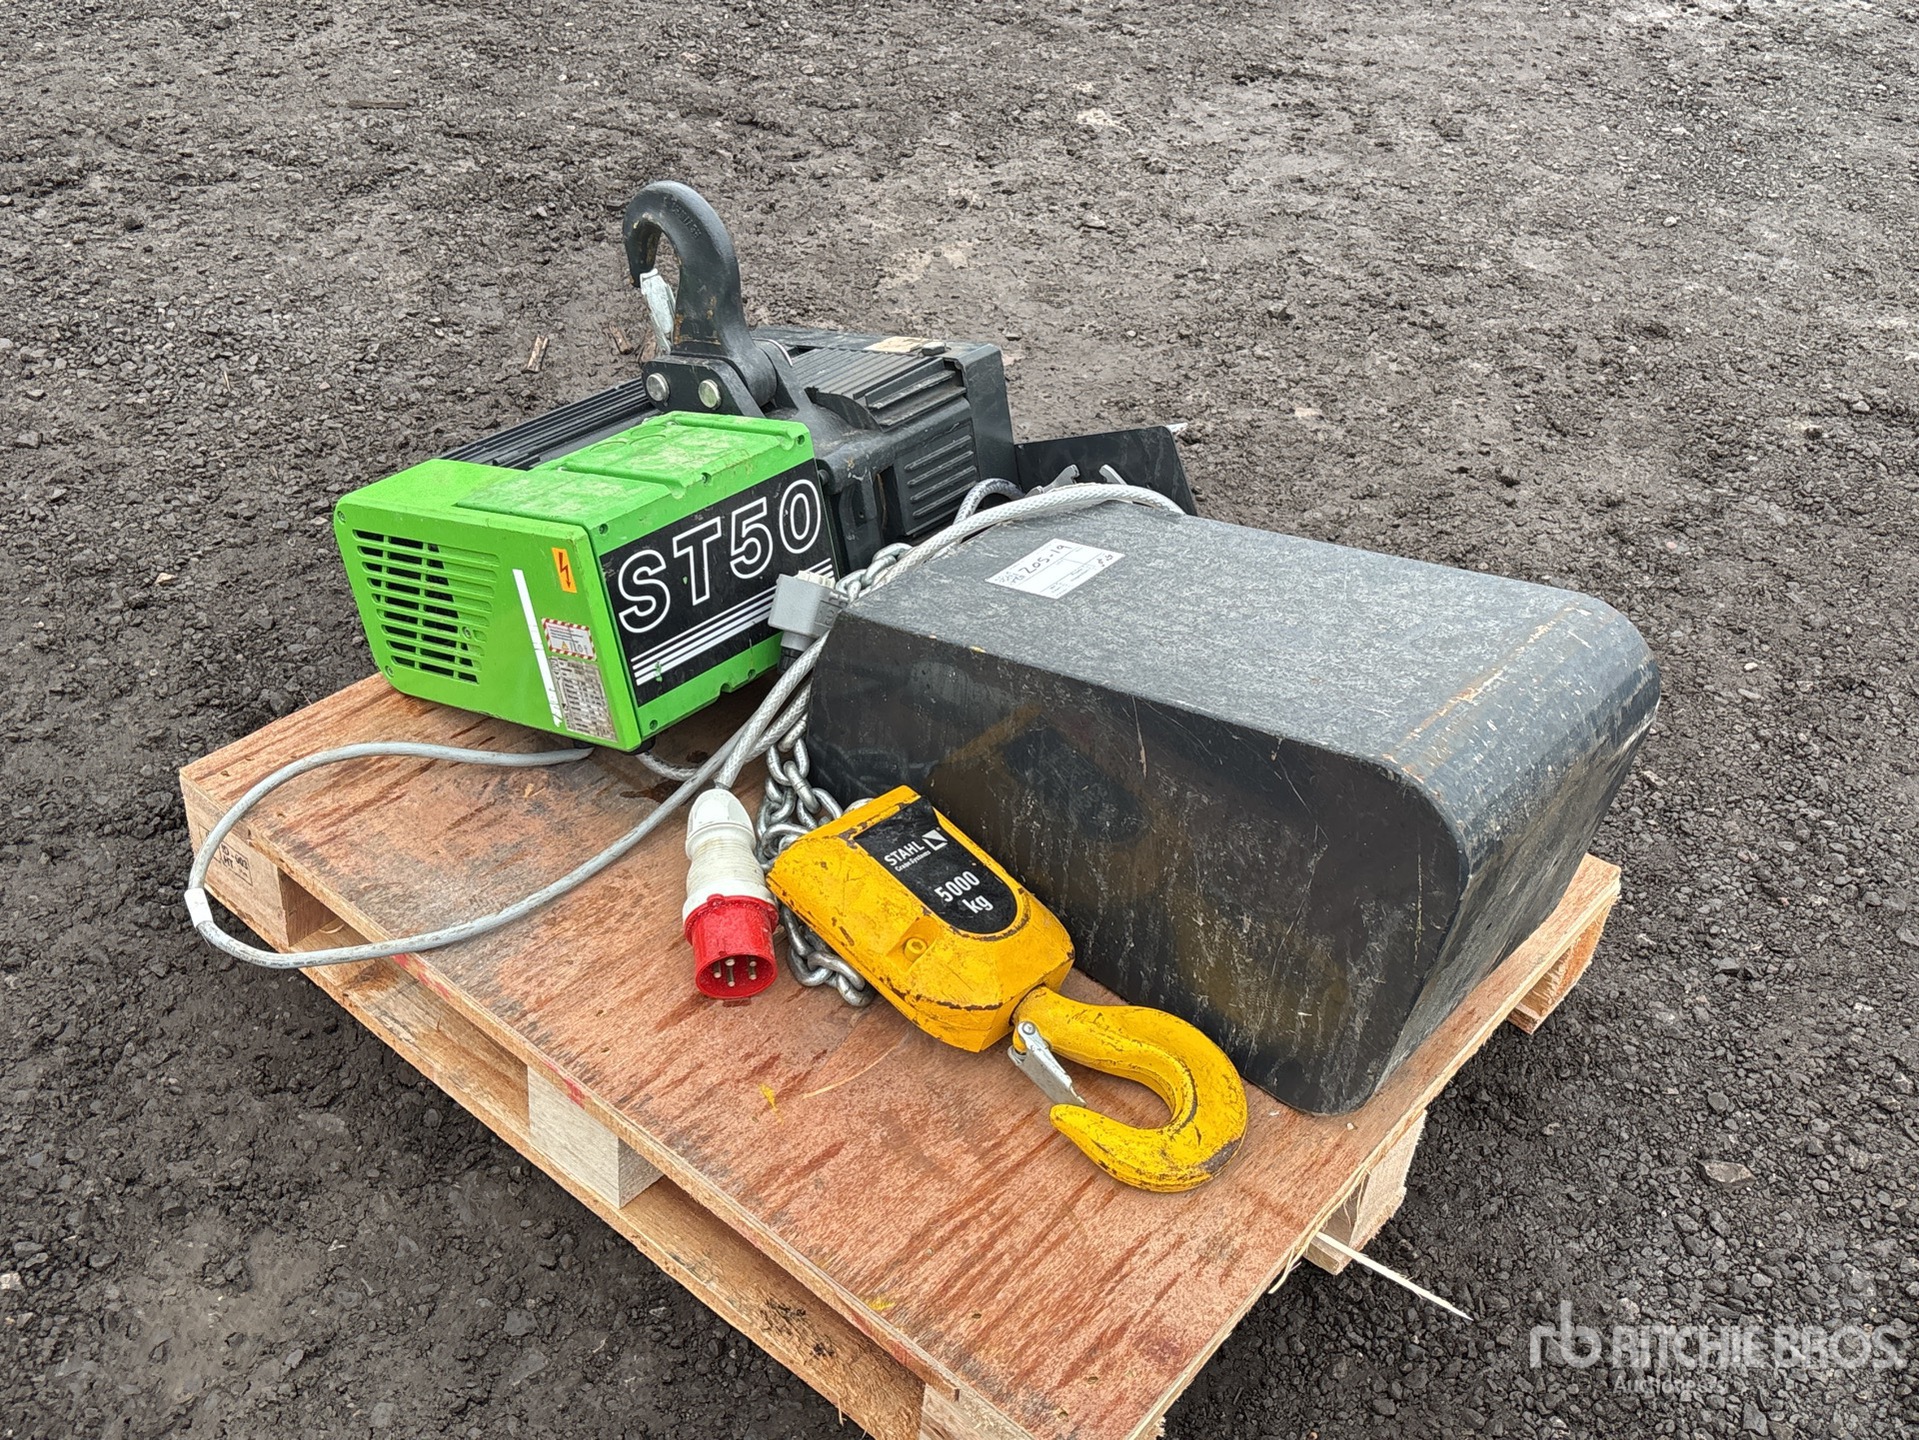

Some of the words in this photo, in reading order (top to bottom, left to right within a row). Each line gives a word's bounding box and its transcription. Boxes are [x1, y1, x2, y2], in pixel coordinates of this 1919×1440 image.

[618, 479, 821, 633] ST50
[884, 841, 925, 866] STAHL
[934, 871, 981, 903] 5000
[962, 895, 994, 914] kg
